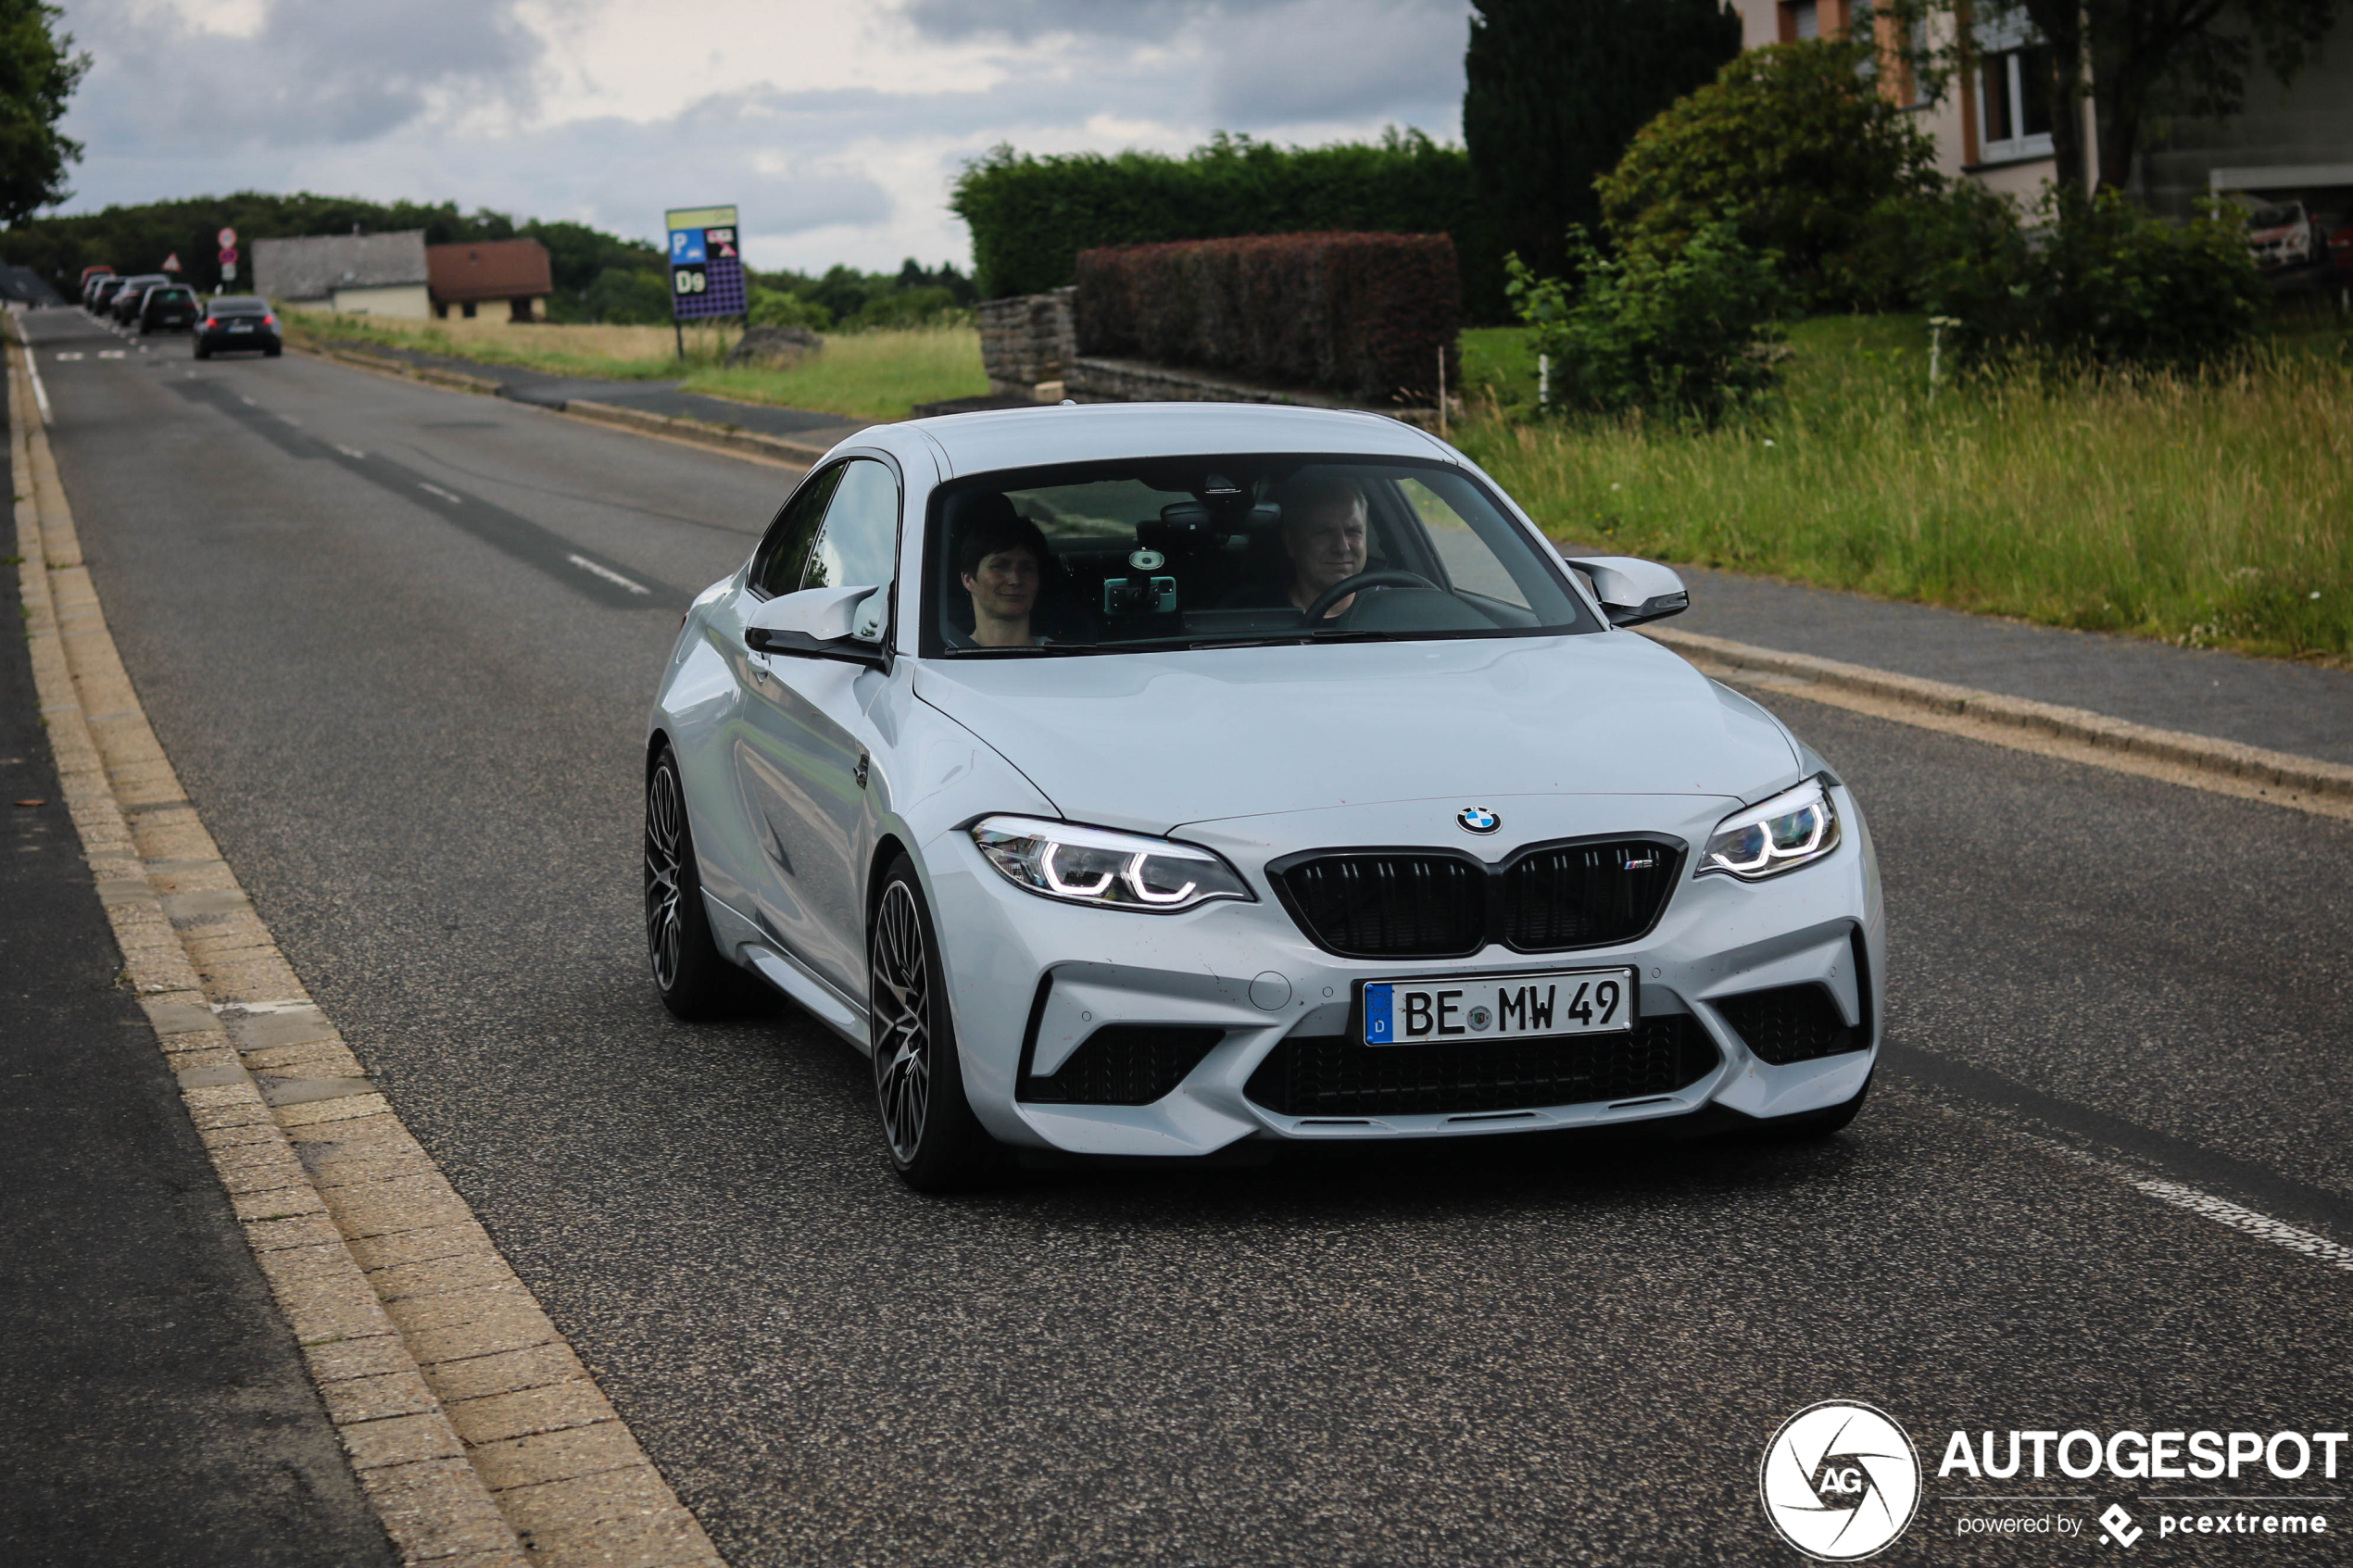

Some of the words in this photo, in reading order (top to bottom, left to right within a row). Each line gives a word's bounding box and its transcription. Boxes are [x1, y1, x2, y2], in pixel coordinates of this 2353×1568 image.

[673, 232, 687, 256] P
[1405, 989, 1466, 1036] BE
[1498, 984, 1556, 1032] MW
[1567, 980, 1620, 1026] 49
[1375, 1020, 1385, 1033] D
